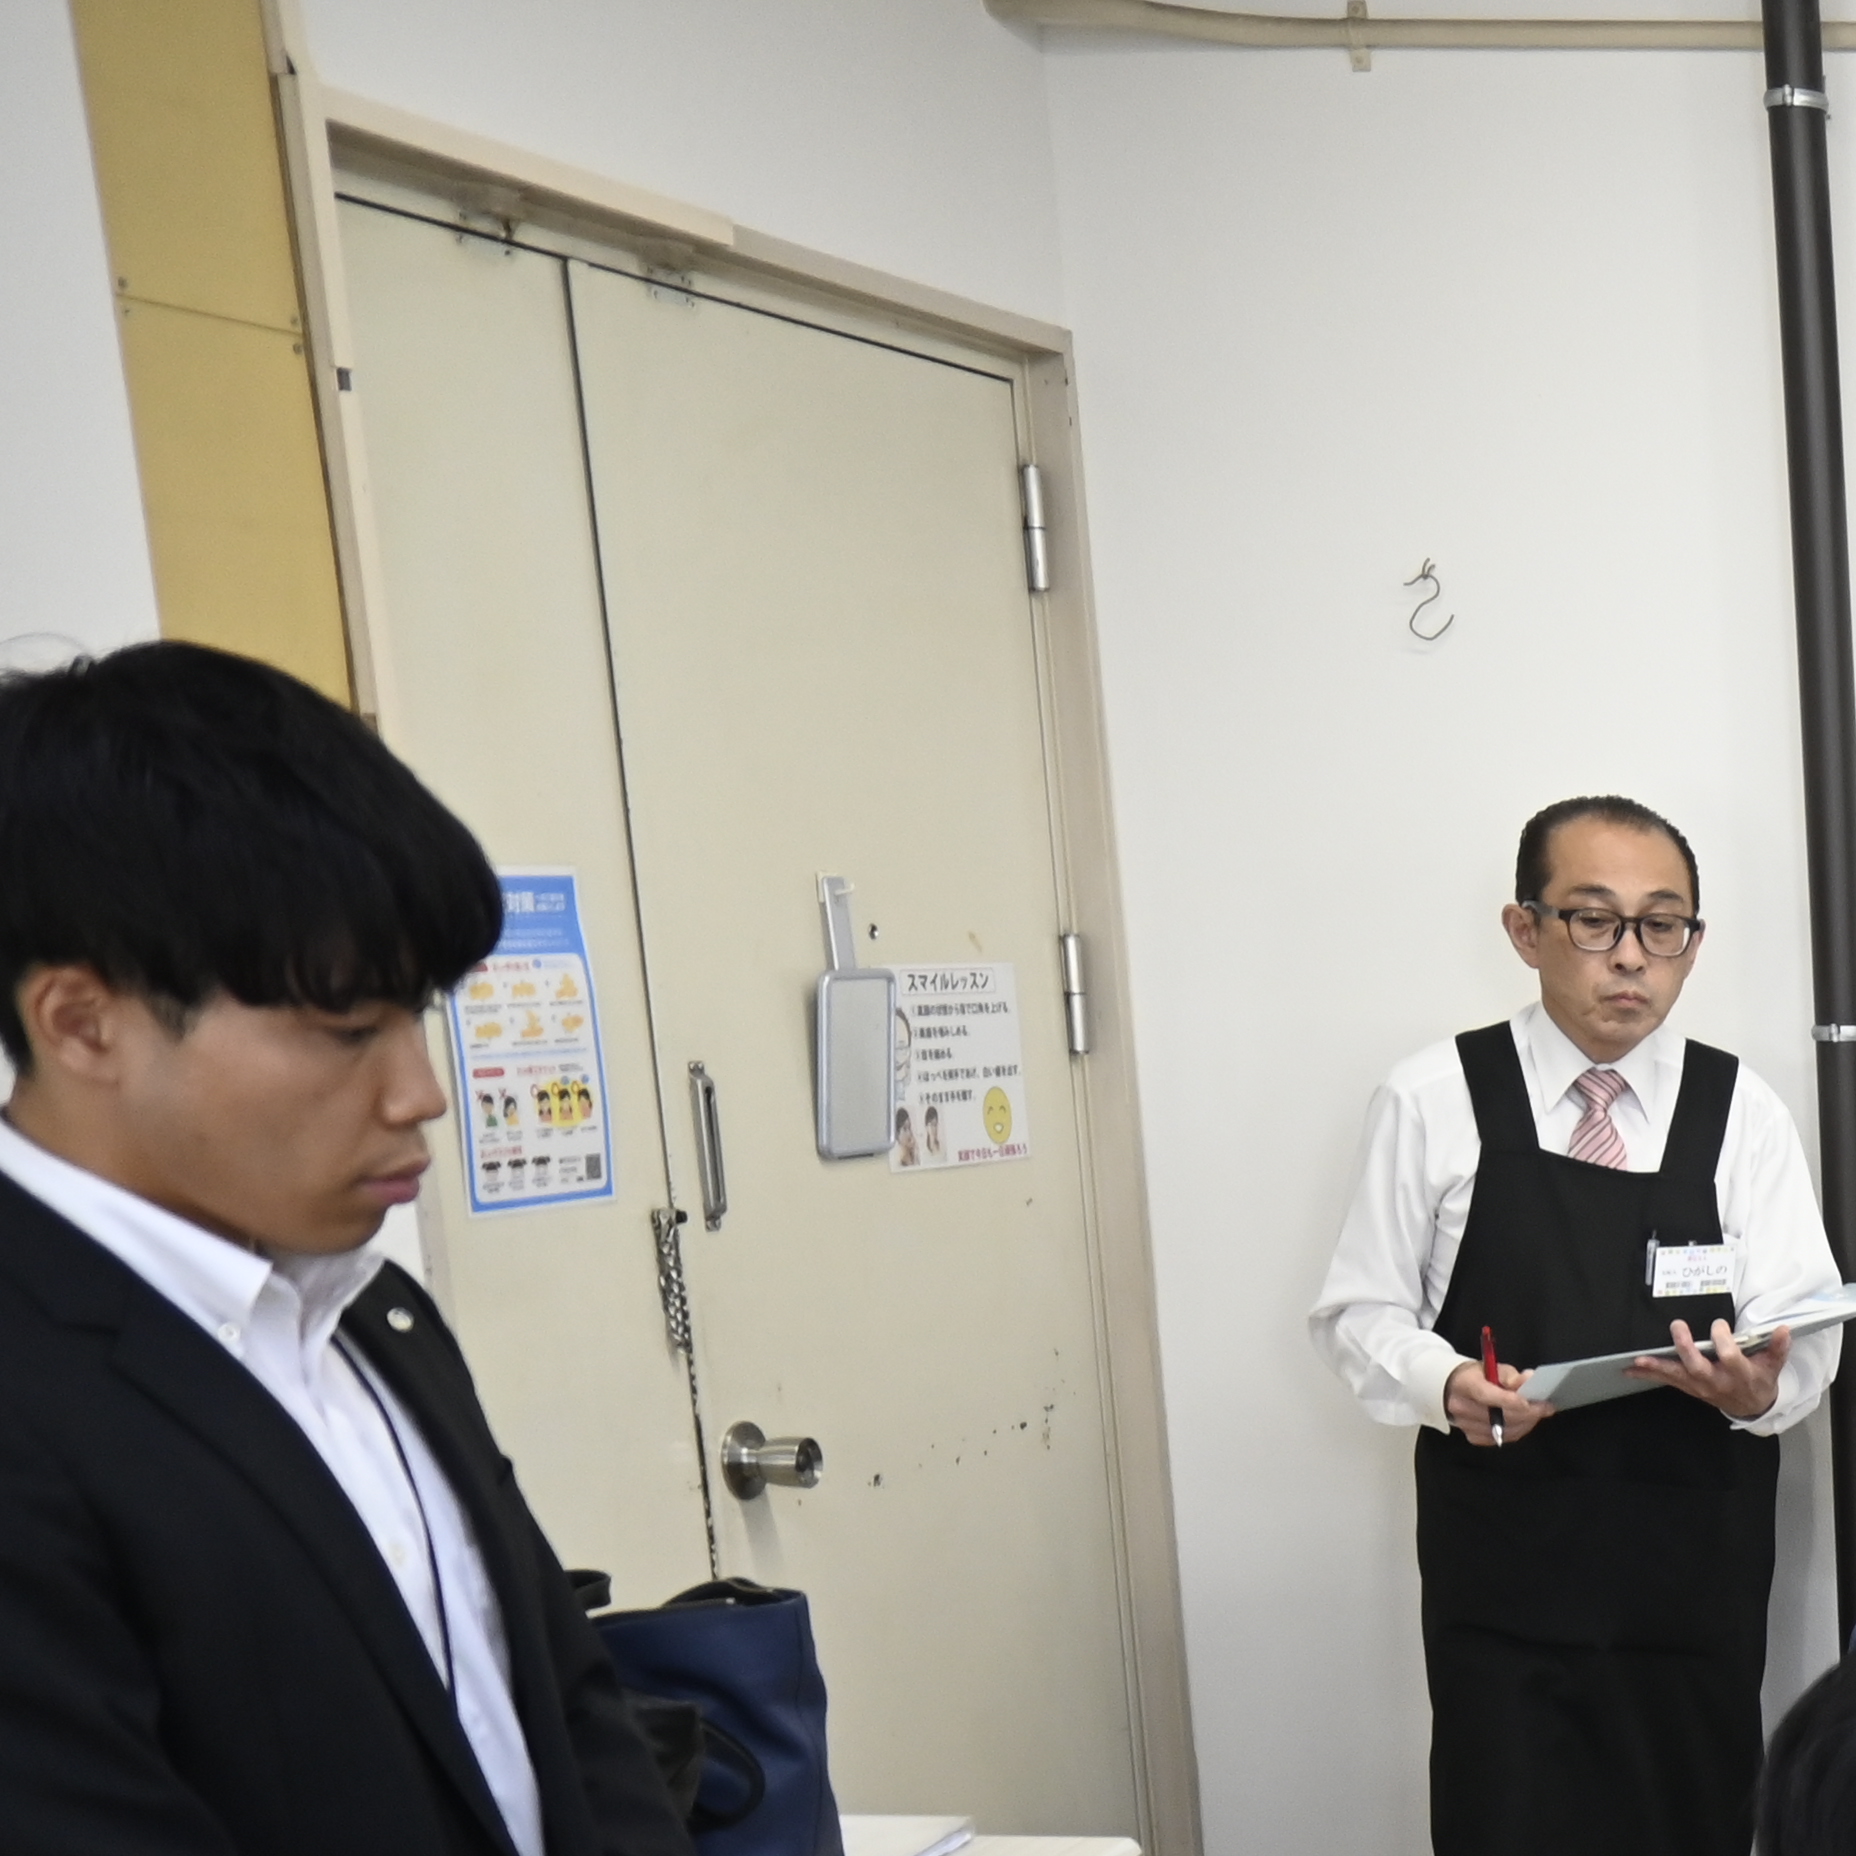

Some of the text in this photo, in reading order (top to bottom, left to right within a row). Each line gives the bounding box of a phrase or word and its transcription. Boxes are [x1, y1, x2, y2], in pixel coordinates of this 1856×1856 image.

[907, 971, 990, 993] スマイルレッスン
[1681, 1264, 1728, 1278] ひがしの
